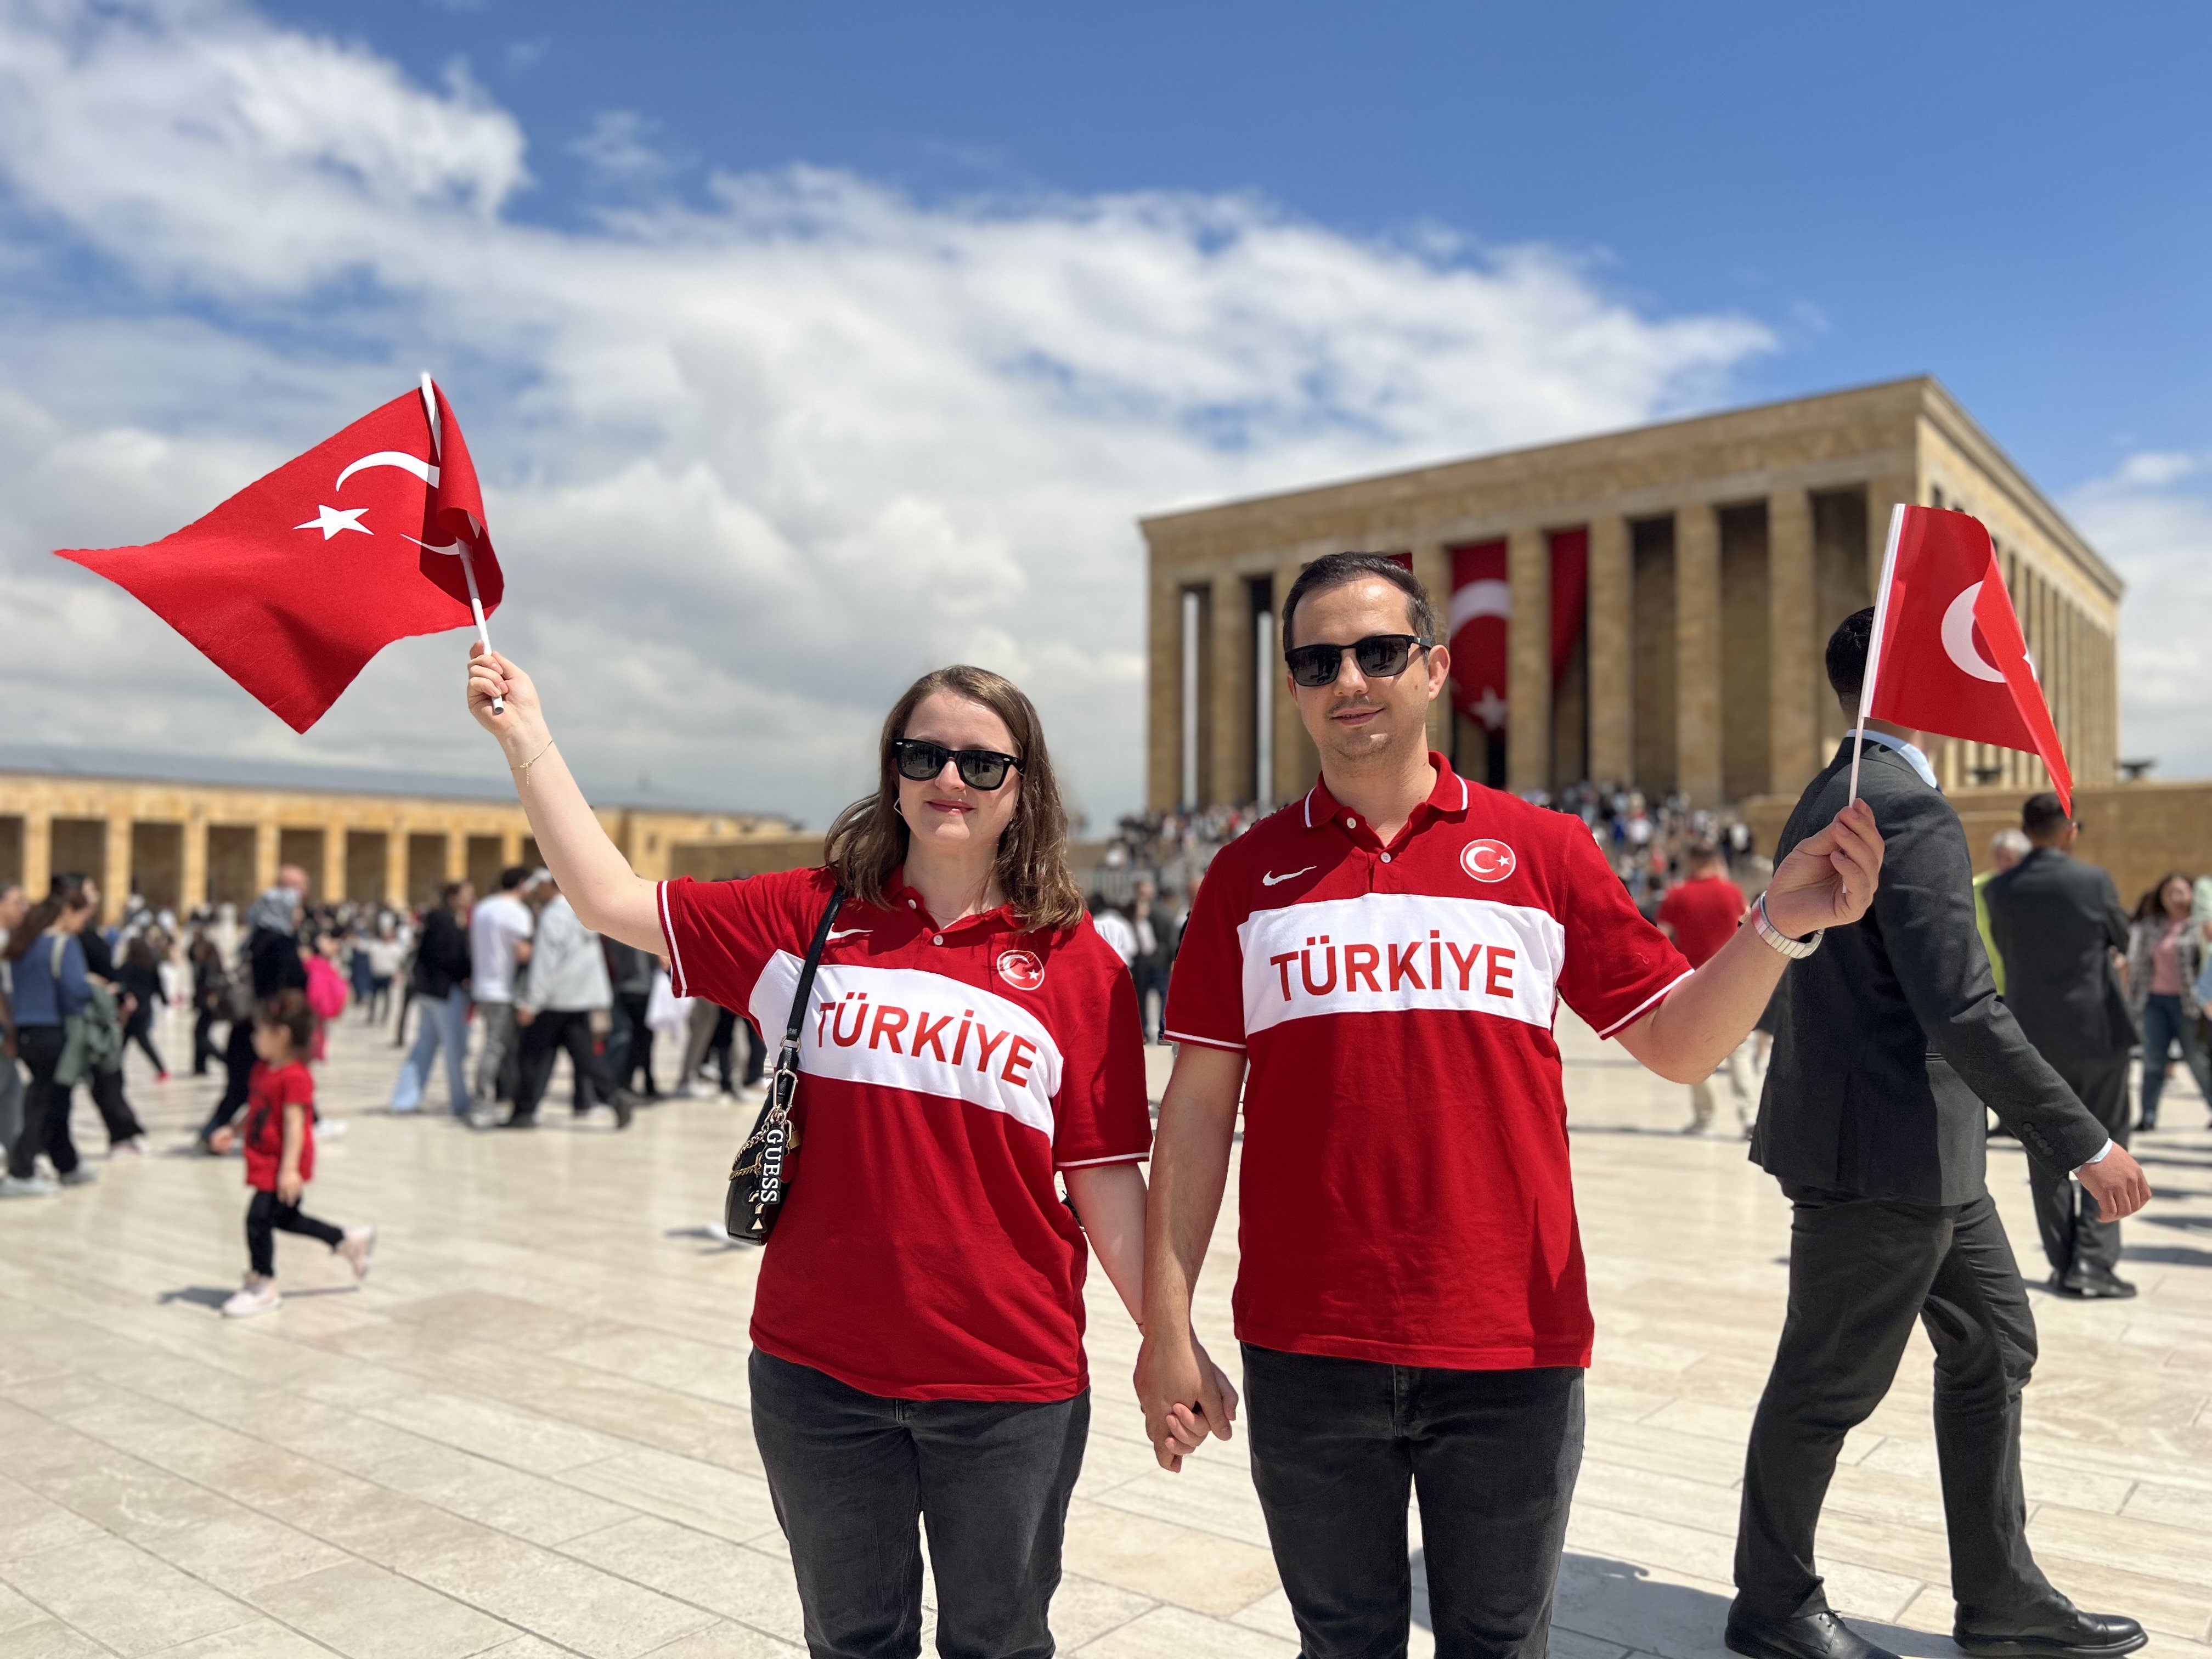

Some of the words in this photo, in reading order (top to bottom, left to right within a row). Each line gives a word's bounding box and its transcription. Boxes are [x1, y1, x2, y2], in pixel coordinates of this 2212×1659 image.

[1270, 929, 1516, 1001] TÜRKİYE
[819, 991, 1037, 1088] TÜRKİYE
[760, 1129, 784, 1202] GUESS
